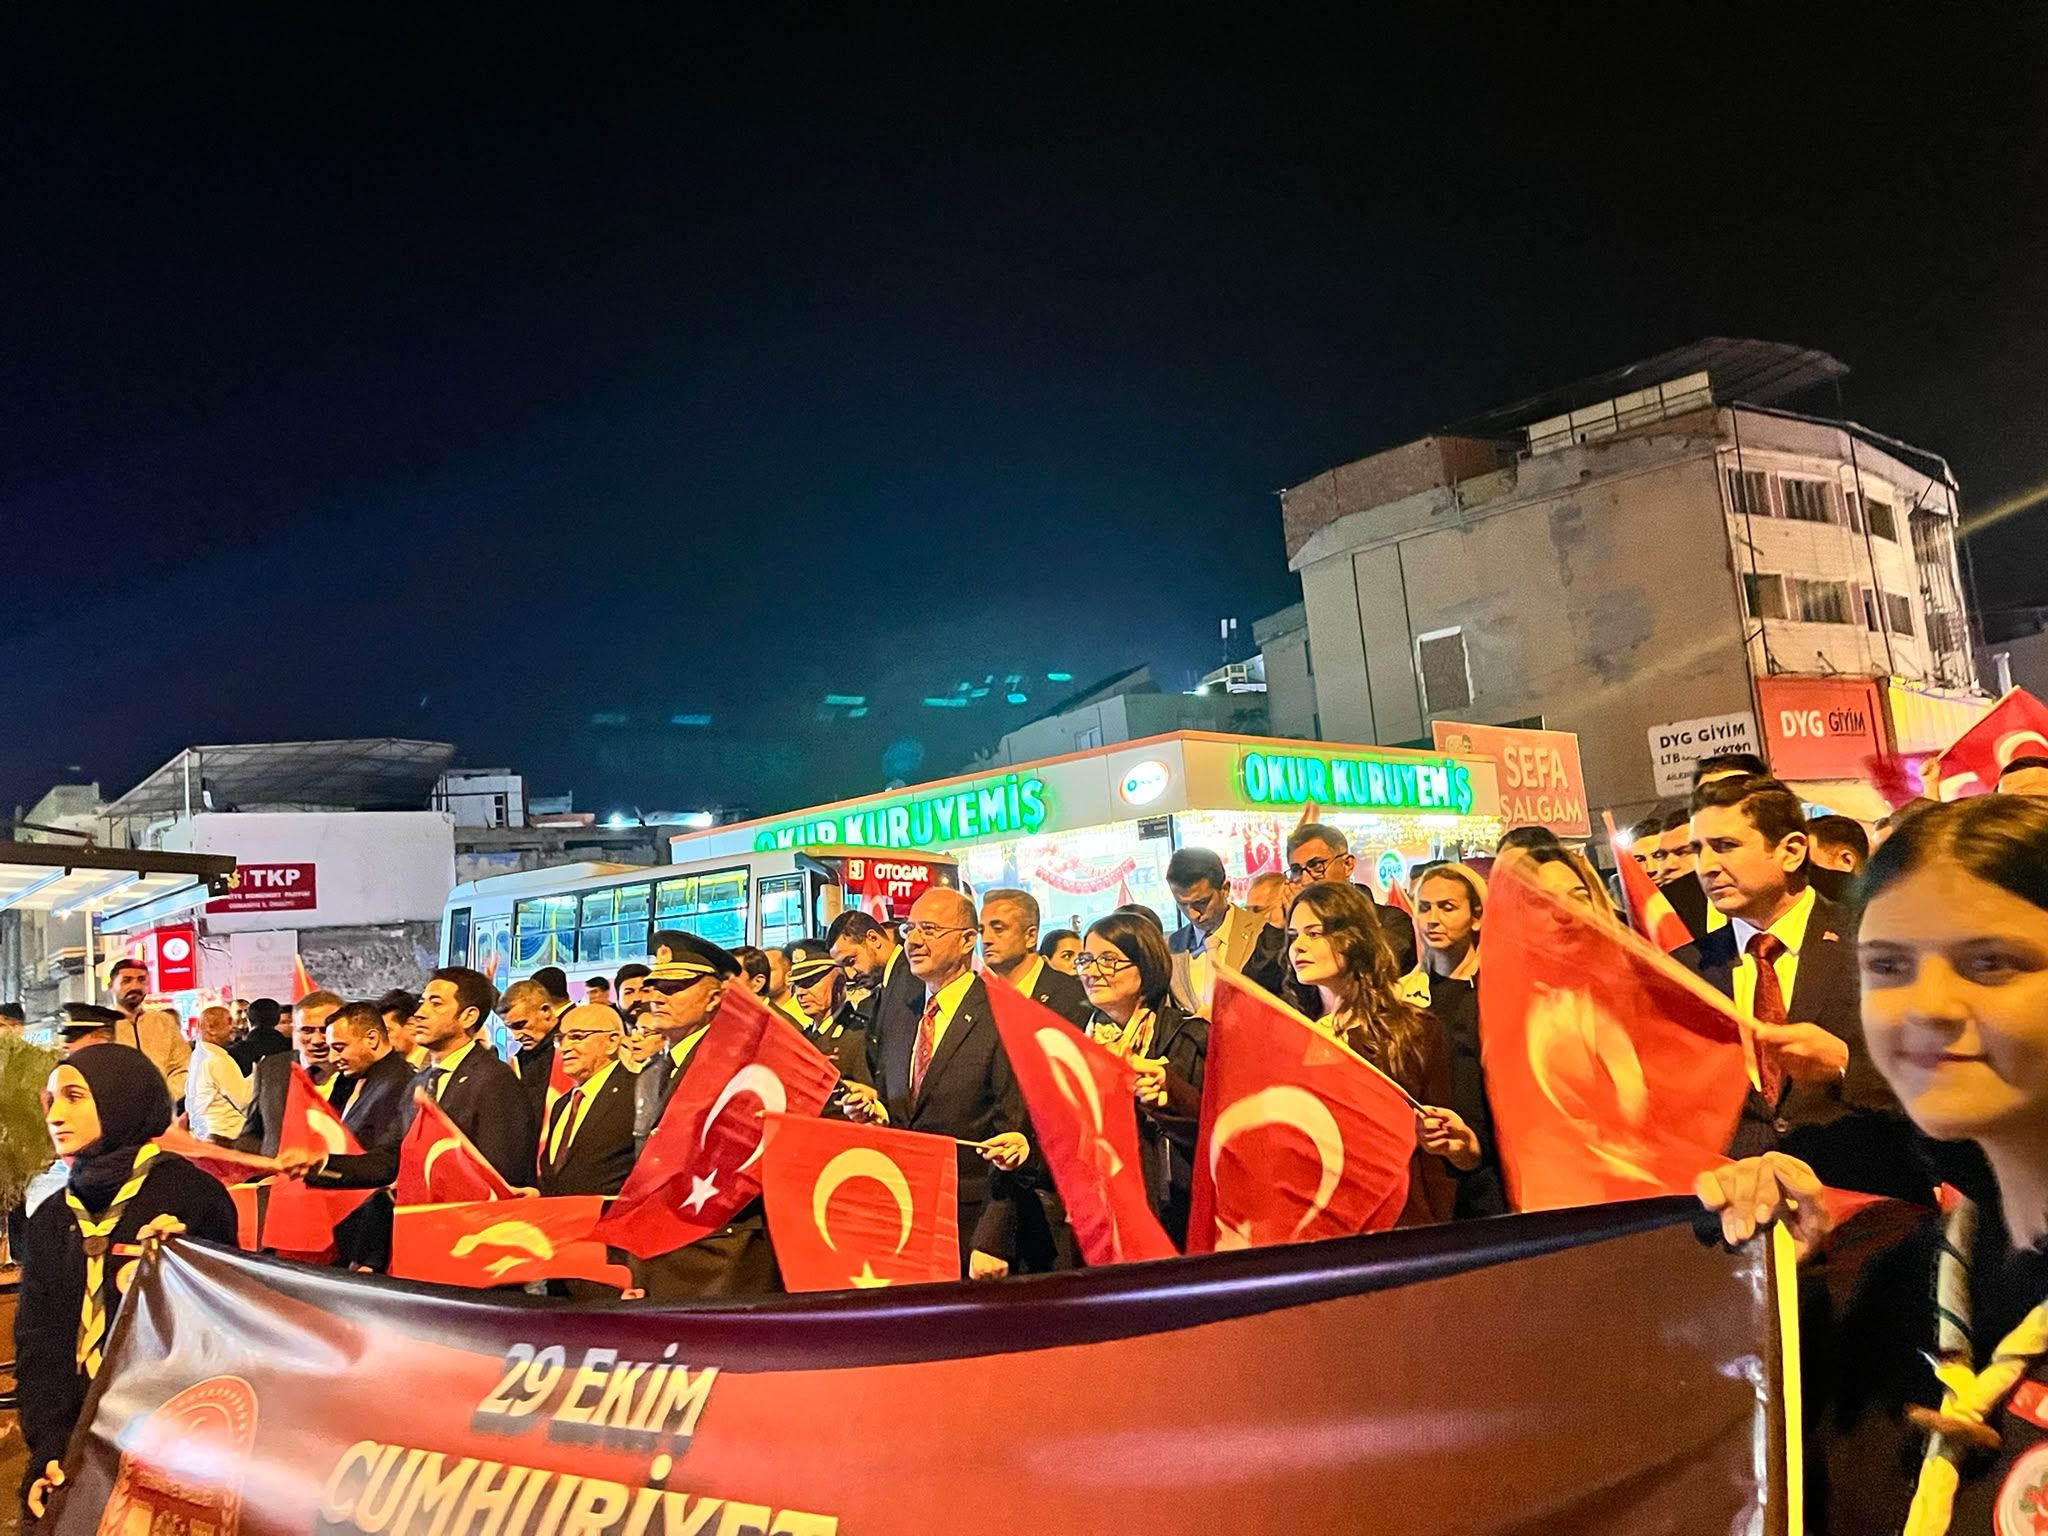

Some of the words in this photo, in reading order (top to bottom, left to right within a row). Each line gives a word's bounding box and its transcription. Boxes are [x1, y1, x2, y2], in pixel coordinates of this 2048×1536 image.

[1660, 732, 1692, 748] DYG
[1698, 722, 1745, 742] GİYİM
[1780, 710, 1824, 738] DYG
[1503, 746, 1569, 790] SEFA
[1245, 753, 1329, 803] OKUR
[1331, 759, 1473, 815] KURUYEMİŞ
[844, 774, 1046, 848] KURUYEMİŞ
[249, 869, 300, 887] TKP
[874, 863, 928, 881] OTOGAR
[888, 881, 913, 897] PTT
[476, 1343, 566, 1417] 29
[551, 1342, 721, 1437] EKİM
